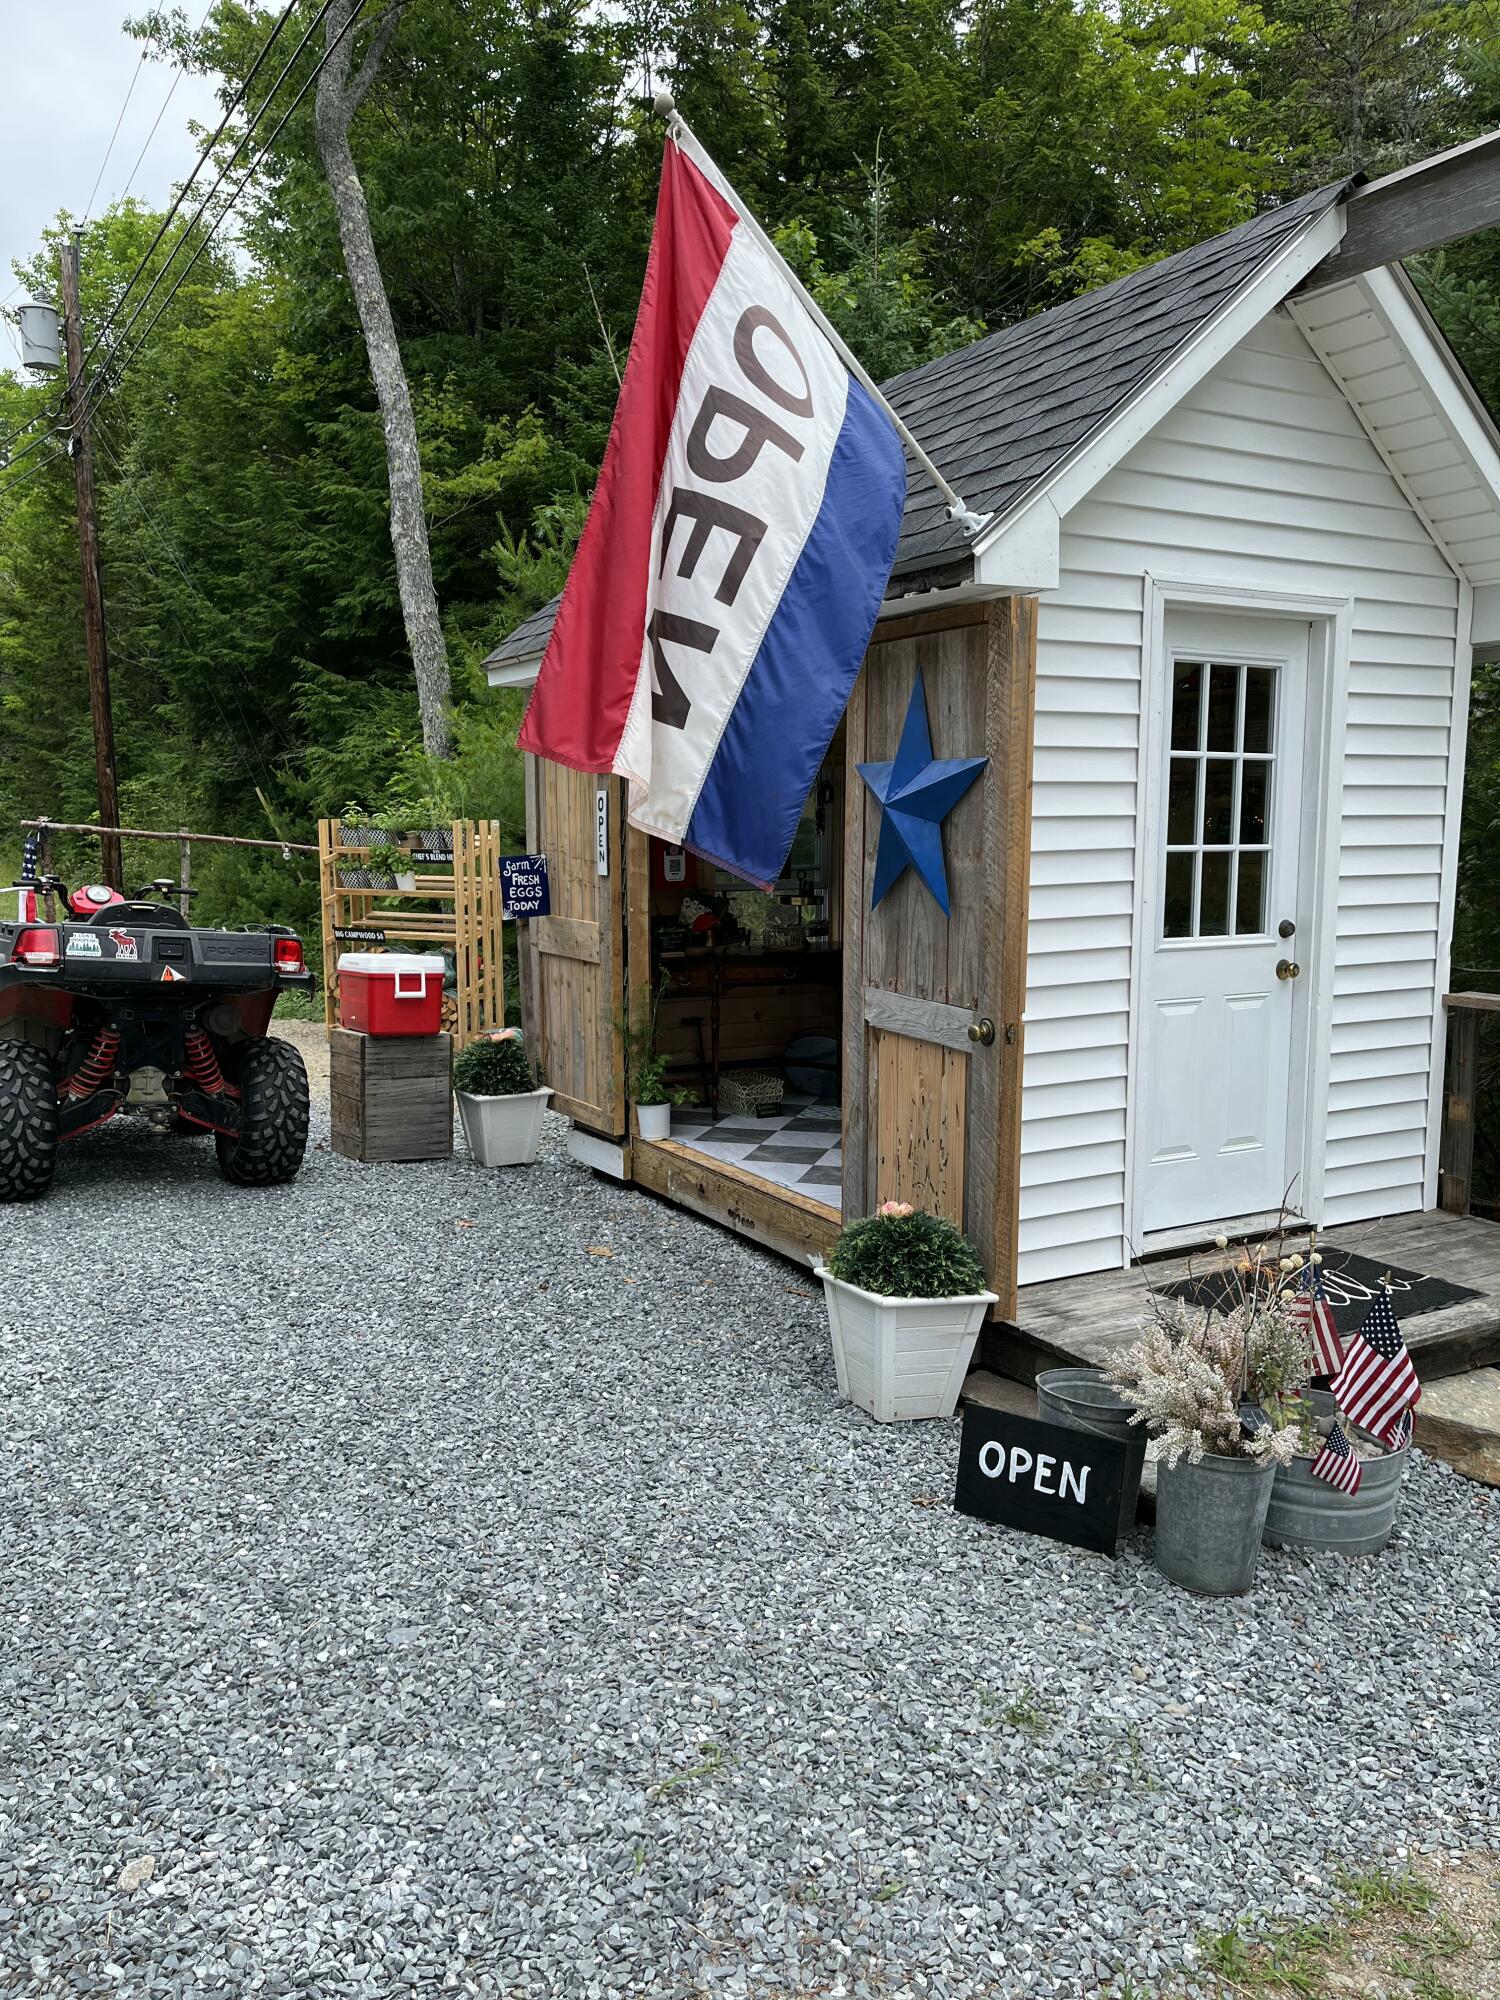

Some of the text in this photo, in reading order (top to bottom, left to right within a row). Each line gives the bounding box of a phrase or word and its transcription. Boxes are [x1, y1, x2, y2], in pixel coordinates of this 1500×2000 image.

[430, 853, 446, 861] BLEND
[503, 860, 531, 877] farm
[512, 873, 540, 886] FRESH
[509, 886, 543, 898] EGGS
[507, 899, 540, 911] TODAY
[207, 946, 268, 956] POLARIS
[978, 1441, 1091, 1505] OPEN
